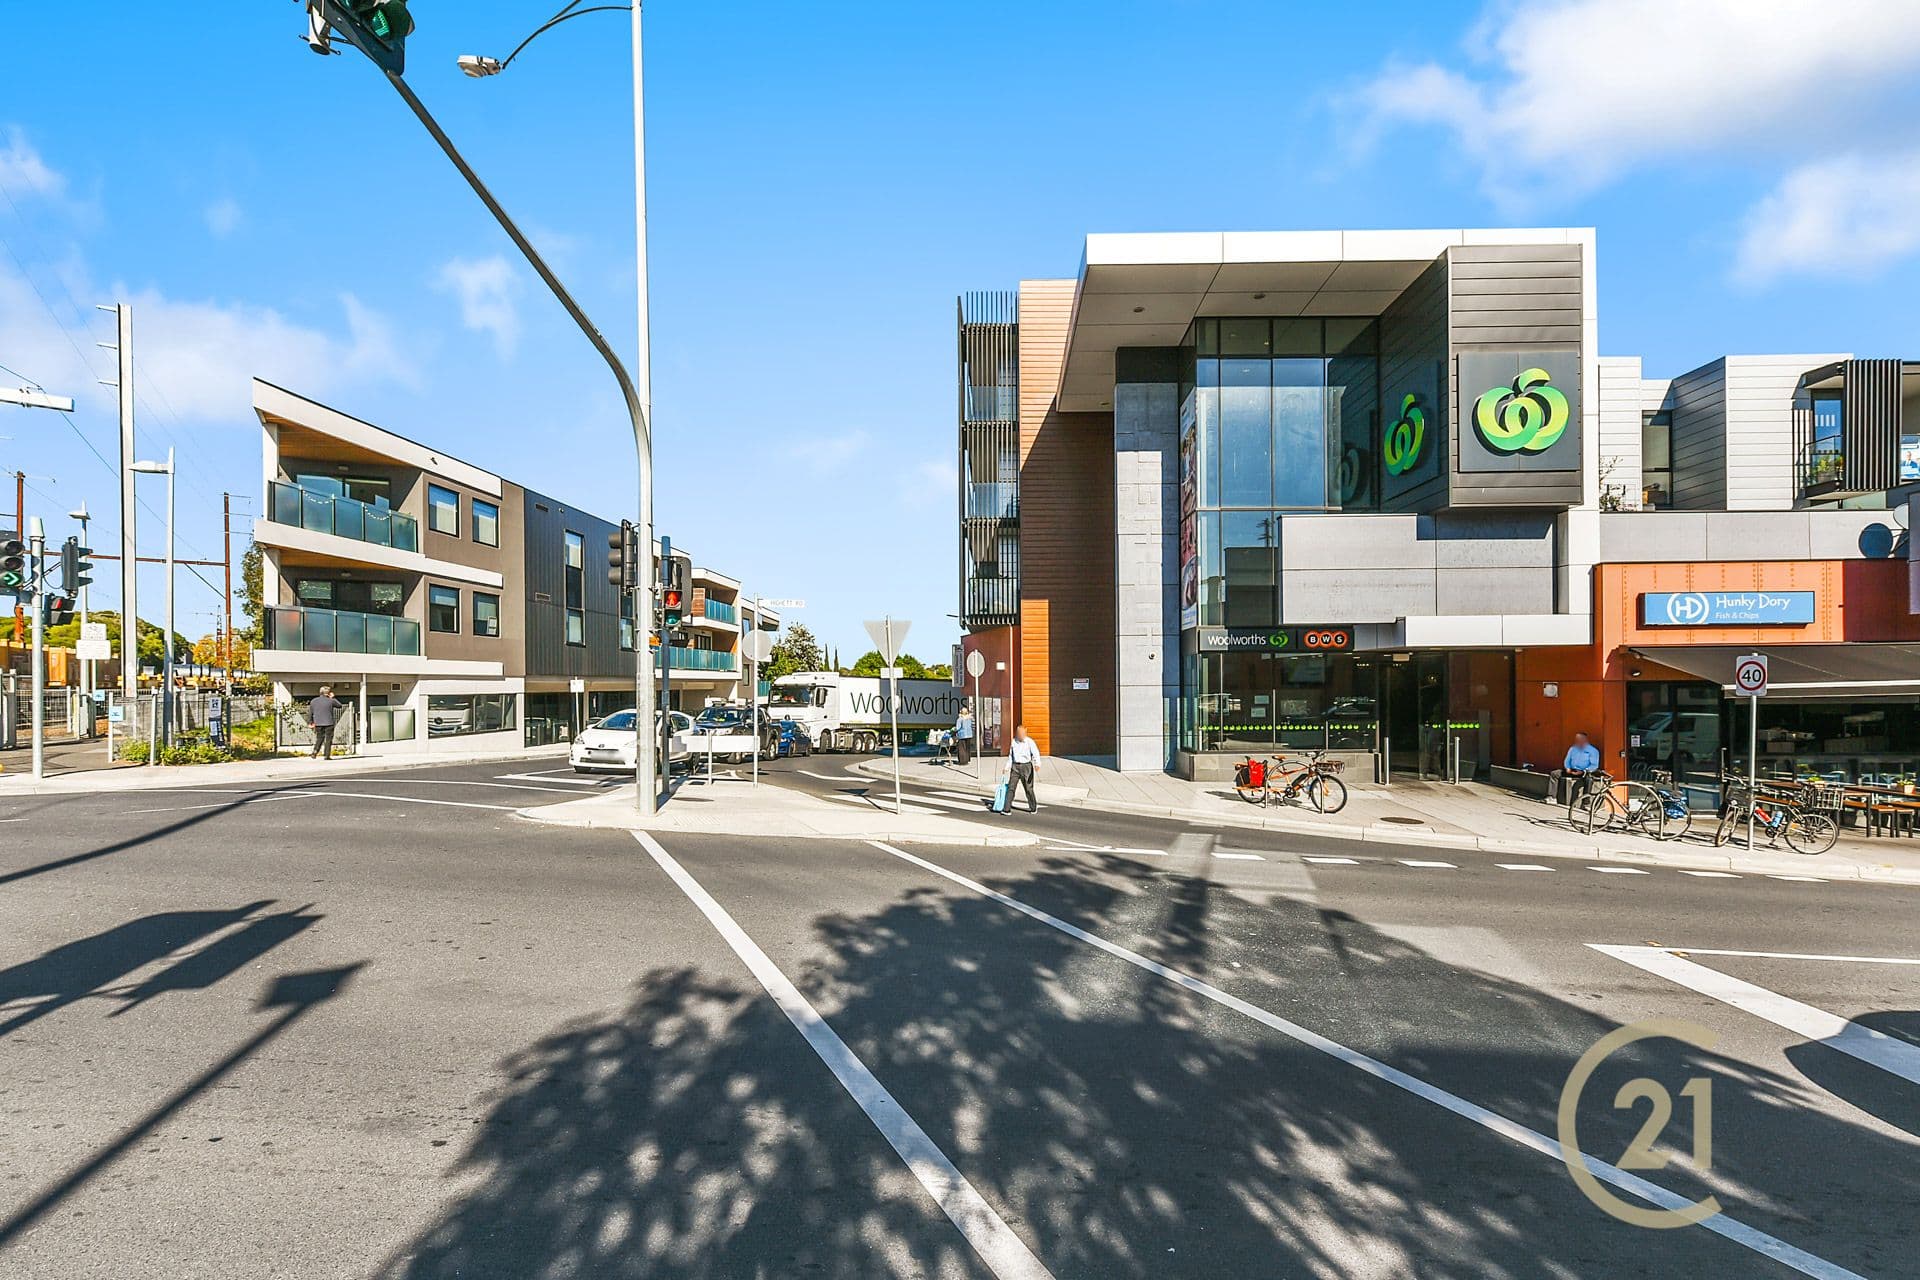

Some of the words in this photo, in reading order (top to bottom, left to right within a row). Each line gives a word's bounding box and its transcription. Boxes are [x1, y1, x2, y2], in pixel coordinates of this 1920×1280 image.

[1715, 593, 1755, 611] Hunky
[1758, 593, 1792, 610] Dory
[1739, 612, 1760, 620] Chips
[1207, 633, 1267, 646] Woolworths
[1309, 634, 1344, 644] BWS
[1741, 669, 1762, 682] 40
